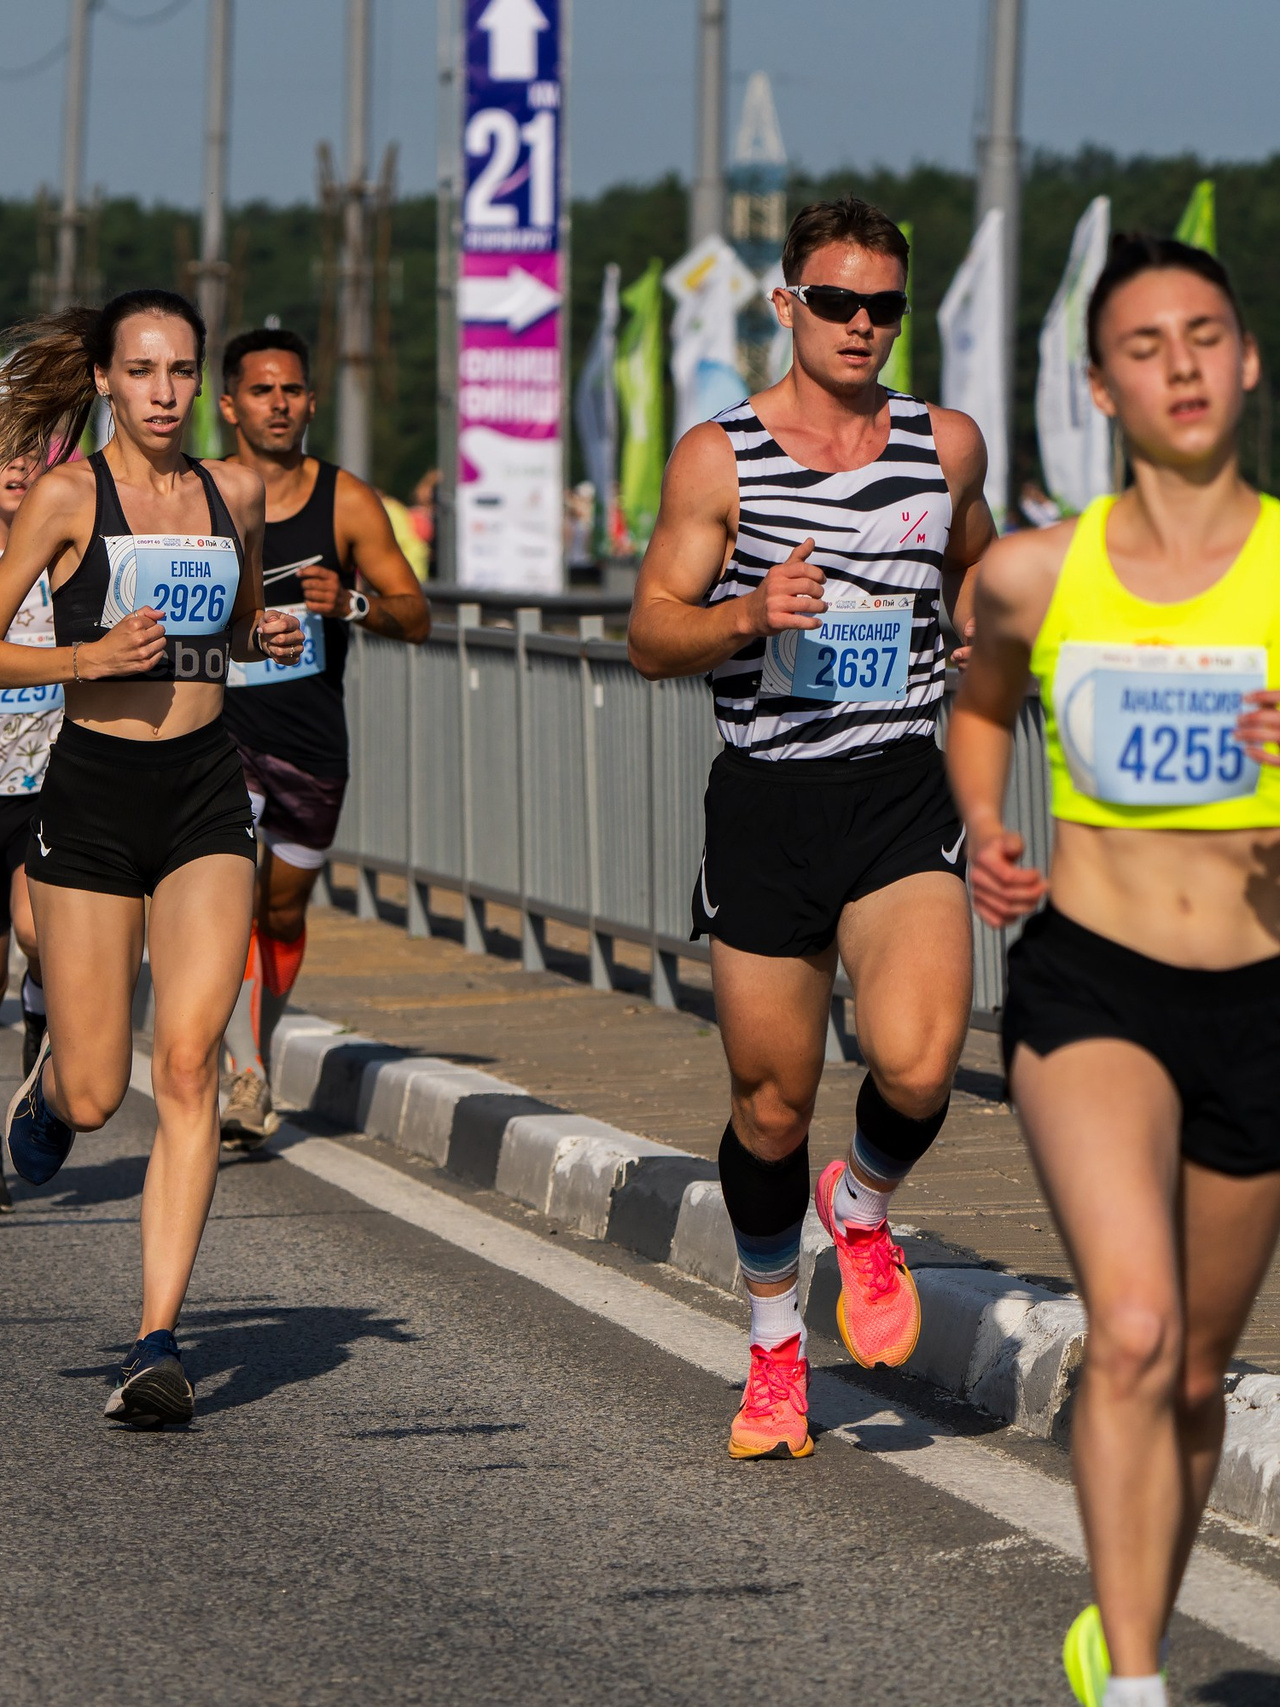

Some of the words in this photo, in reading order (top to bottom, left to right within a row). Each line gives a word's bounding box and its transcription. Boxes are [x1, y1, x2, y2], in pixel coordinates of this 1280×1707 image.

[466, 108, 554, 227] 21
[901, 512, 910, 522] U
[916, 533, 926, 544] M
[171, 560, 212, 578] ЕЛЕНА
[153, 583, 226, 623] 2926
[882, 599, 895, 607] Пэй
[819, 622, 901, 642] АЛЕКСАНДР
[814, 646, 898, 688] 2637
[1118, 725, 1244, 783] 4255
